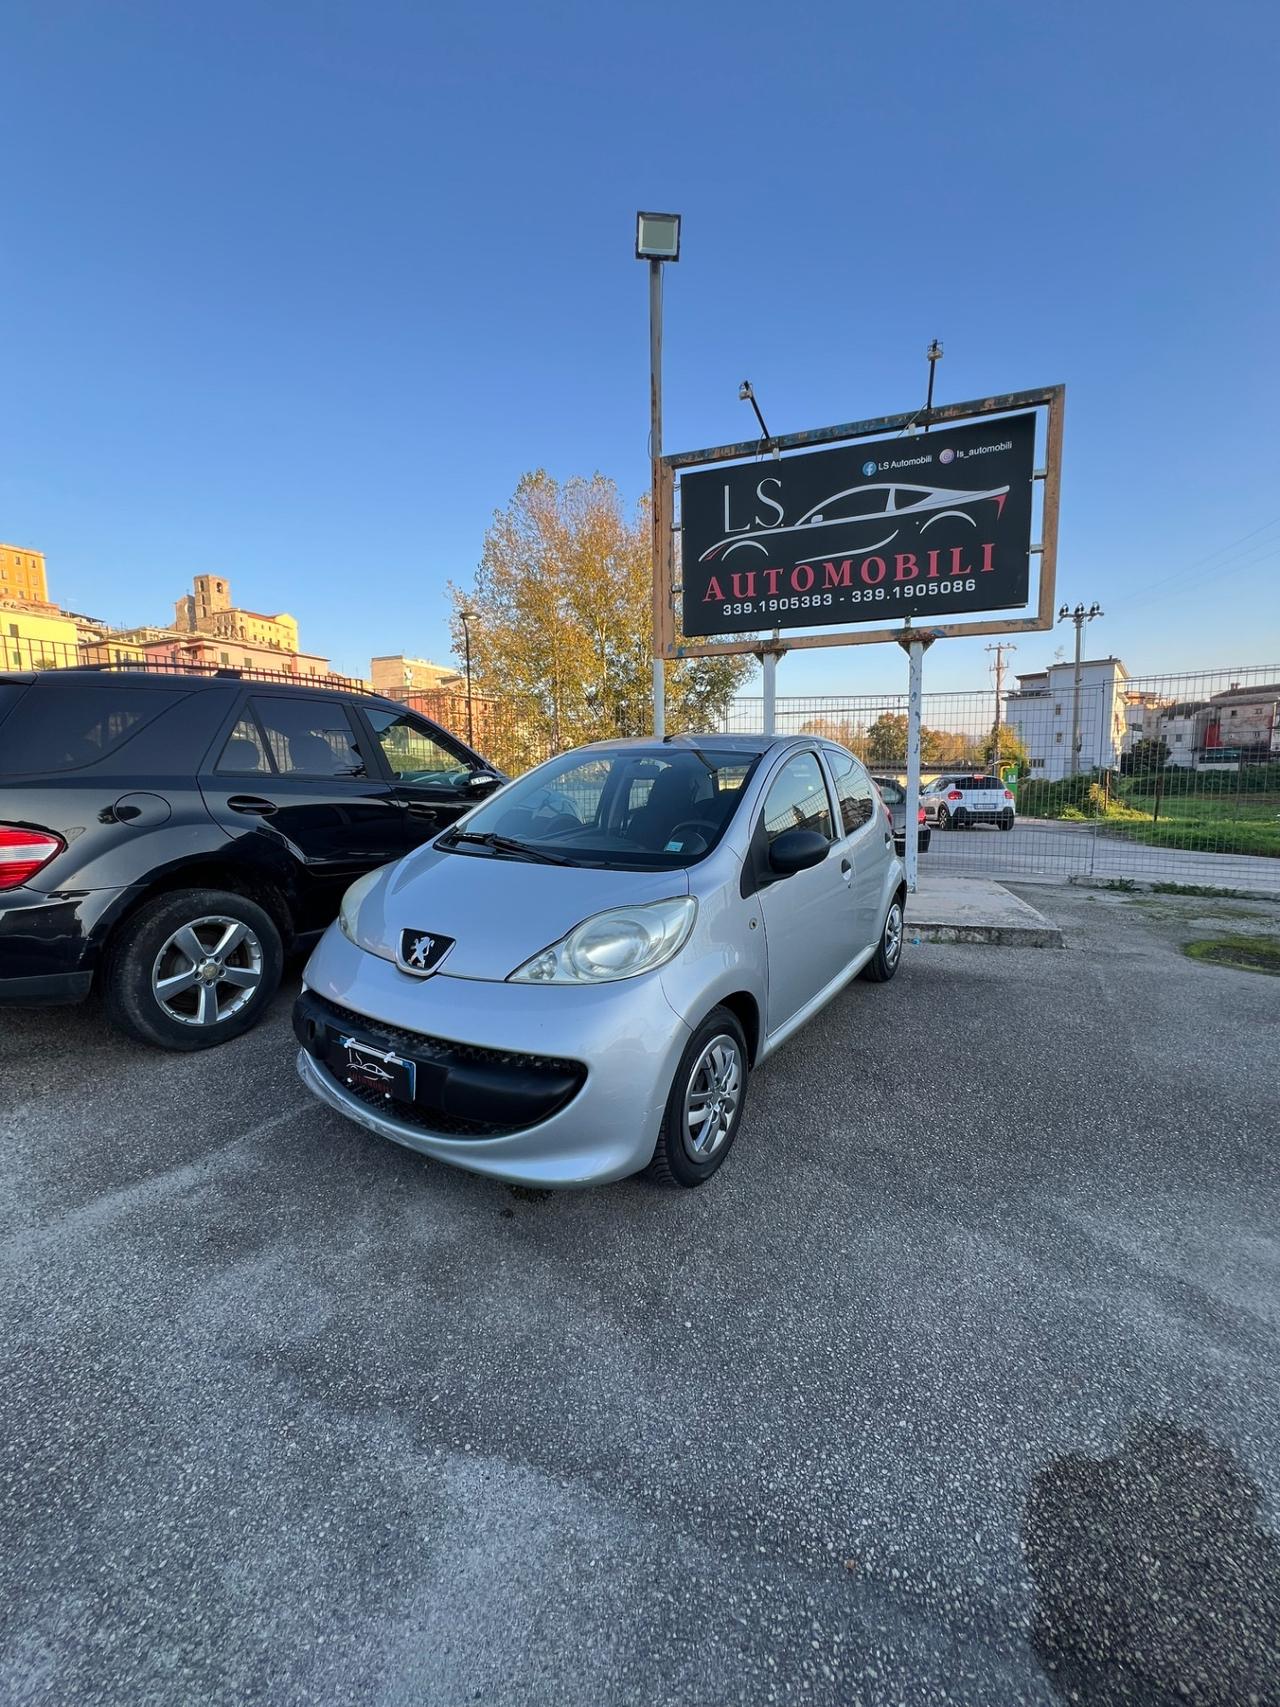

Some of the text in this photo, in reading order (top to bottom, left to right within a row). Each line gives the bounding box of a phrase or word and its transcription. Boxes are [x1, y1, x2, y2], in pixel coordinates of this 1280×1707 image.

[878, 455, 933, 471] LS Automobili
[724, 477, 785, 533] LS
[702, 543, 996, 602] AUTOMOBILI
[723, 593, 833, 616] 339.1905383
[851, 578, 977, 603] 339.1905086
